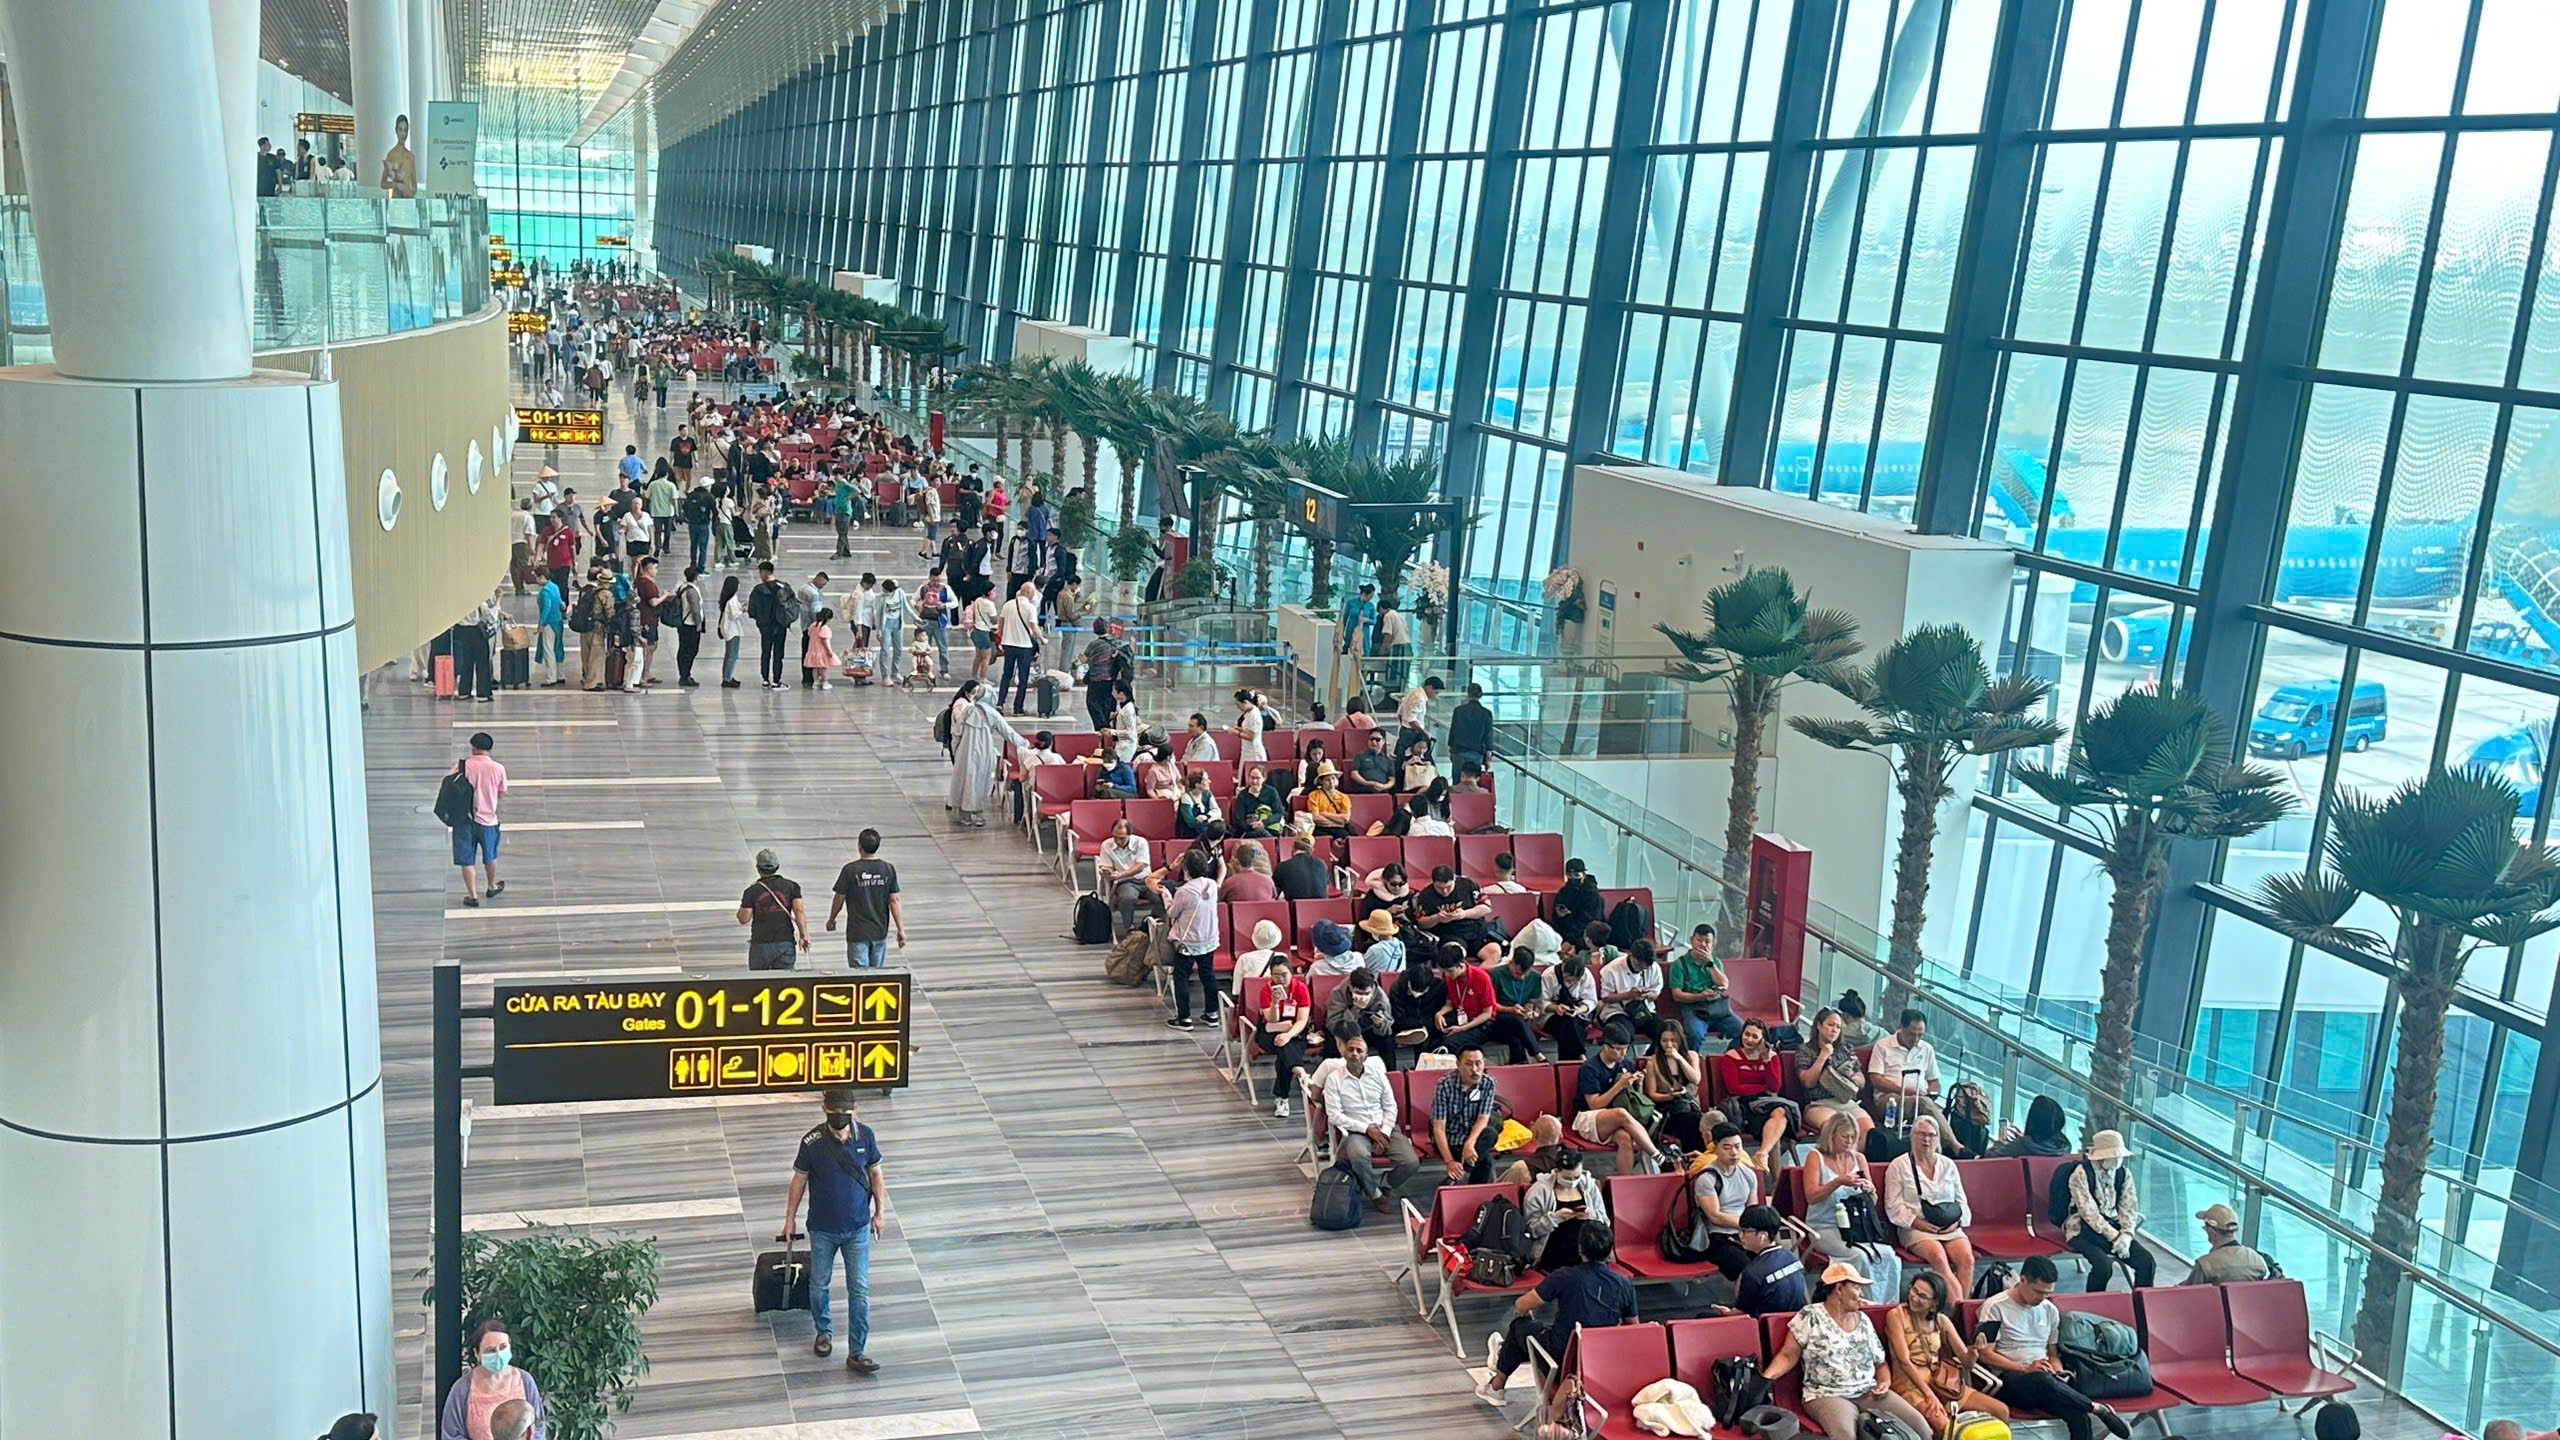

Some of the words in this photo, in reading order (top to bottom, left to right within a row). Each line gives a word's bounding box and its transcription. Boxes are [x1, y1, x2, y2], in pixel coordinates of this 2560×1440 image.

[533, 410, 572, 424] 01-11
[1305, 497, 1316, 522] 12
[506, 993, 549, 1013] CỬA
[553, 995, 581, 1011] RA
[584, 991, 623, 1010] TÀU
[628, 992, 666, 1009] BAY
[675, 987, 805, 1030] 01-12
[622, 1017, 666, 1031] Gates
